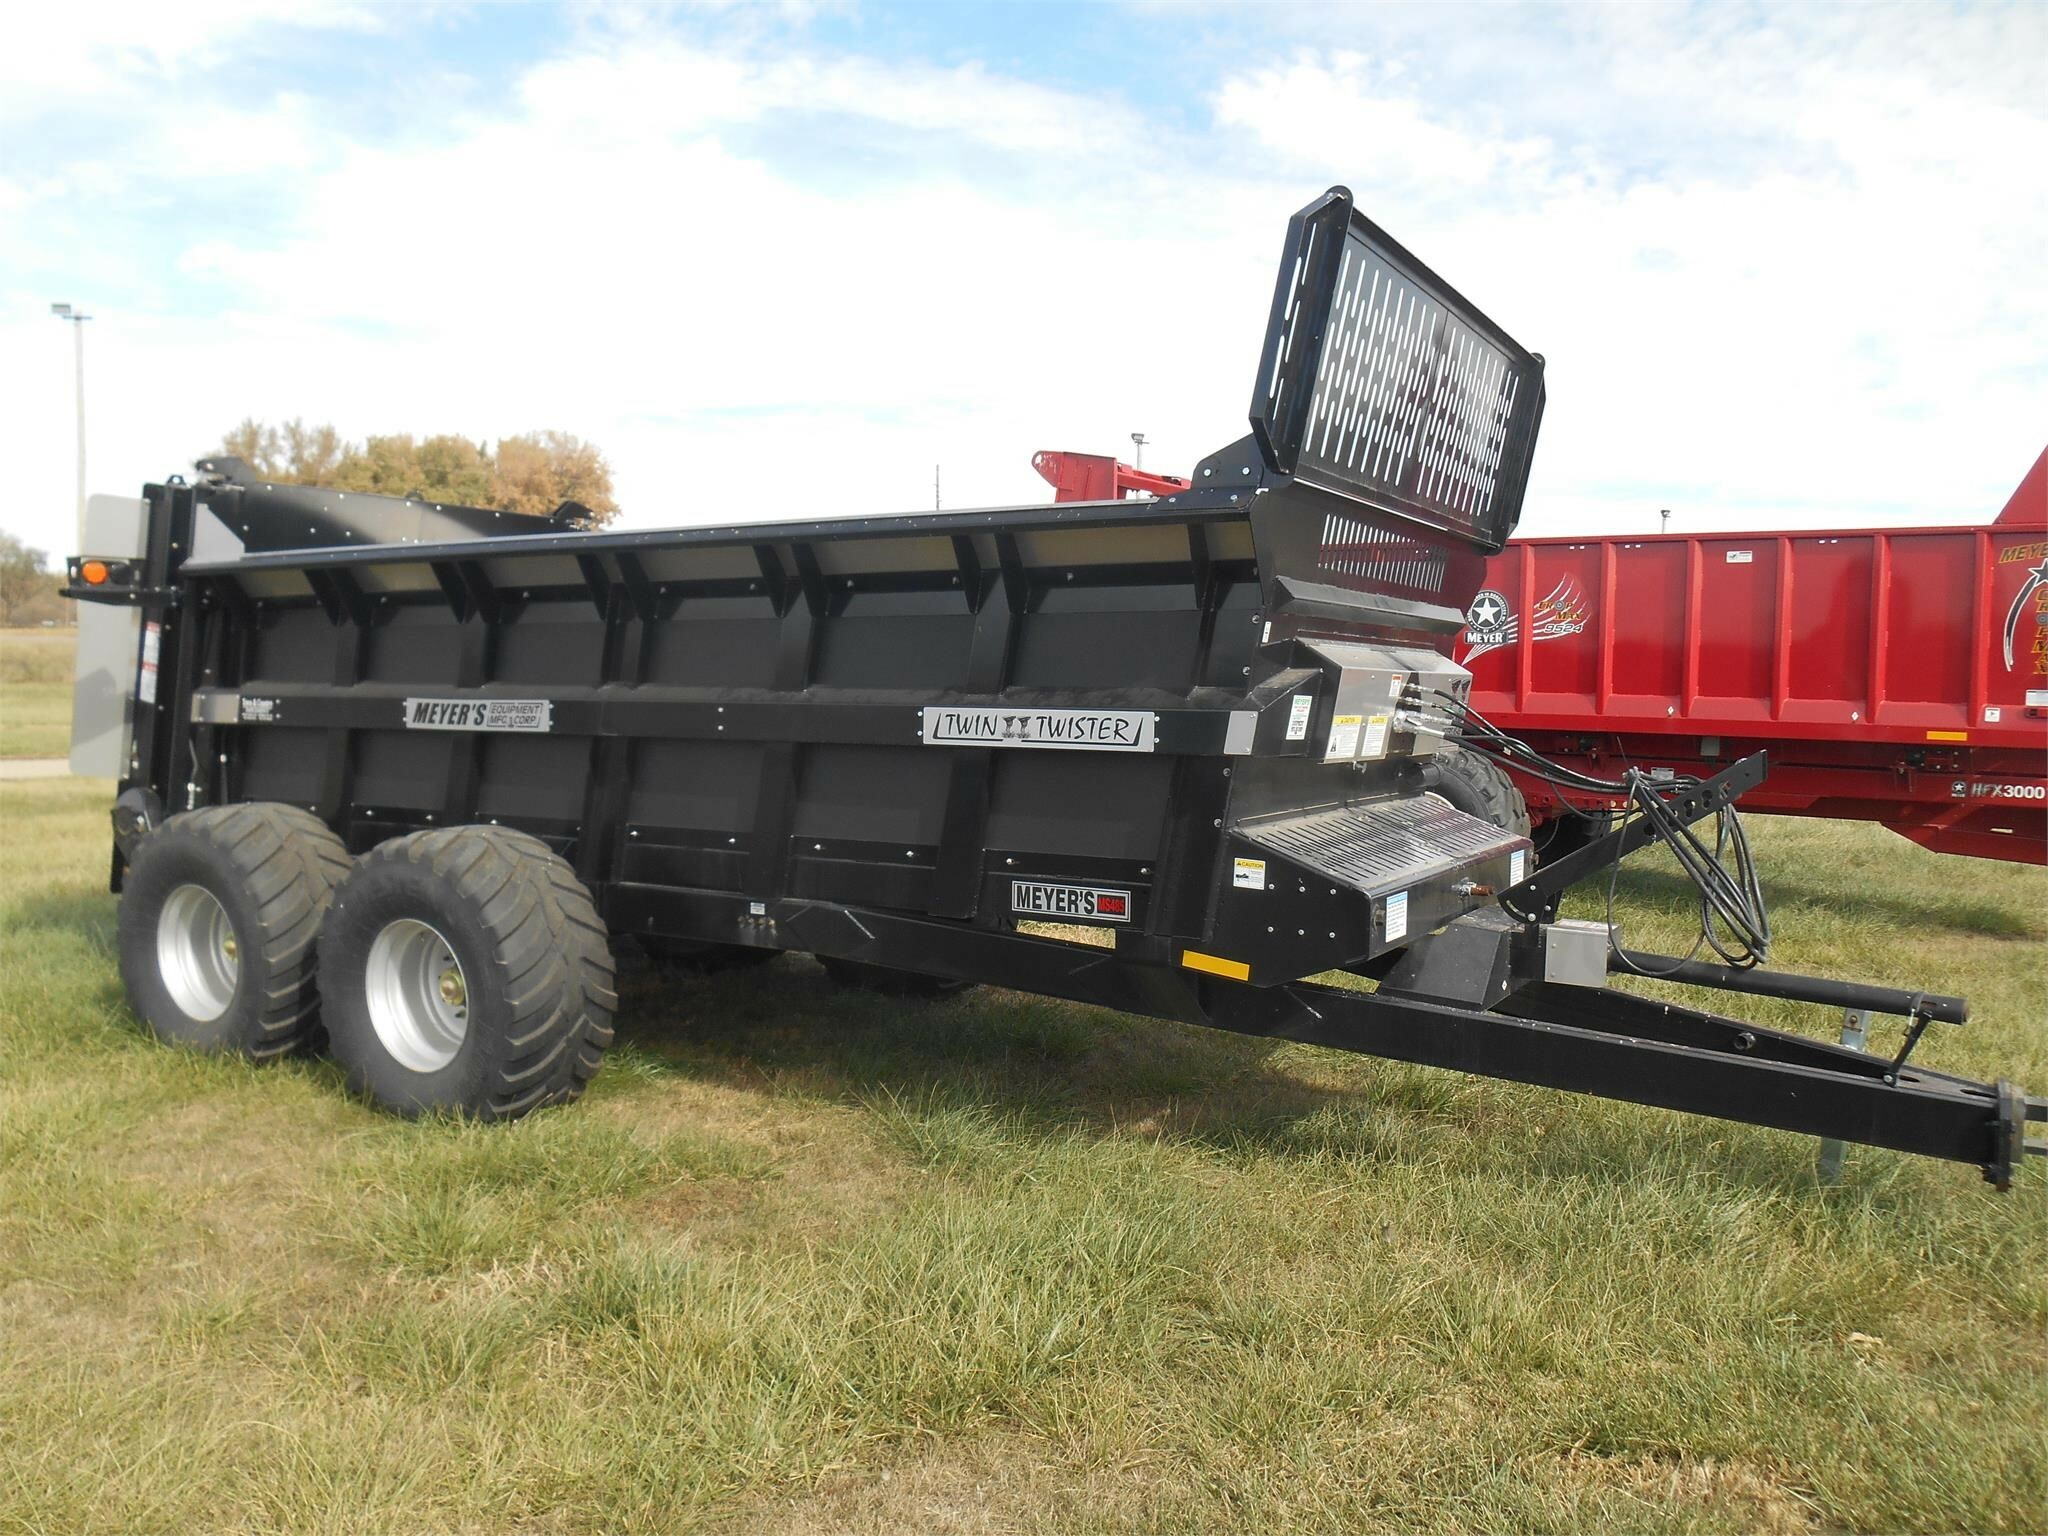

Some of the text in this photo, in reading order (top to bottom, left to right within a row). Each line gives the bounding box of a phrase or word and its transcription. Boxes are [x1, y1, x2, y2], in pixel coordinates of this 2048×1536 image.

[1545, 624, 1584, 633] 9524
[1467, 632, 1504, 643] MEYER
[412, 703, 487, 726] MEYER'S
[491, 704, 541, 714] EQUIPMENT
[945, 714, 1129, 743] TWIN TWISTER
[1241, 861, 1264, 869] CAUTION
[1016, 885, 1095, 914] MEYER'S
